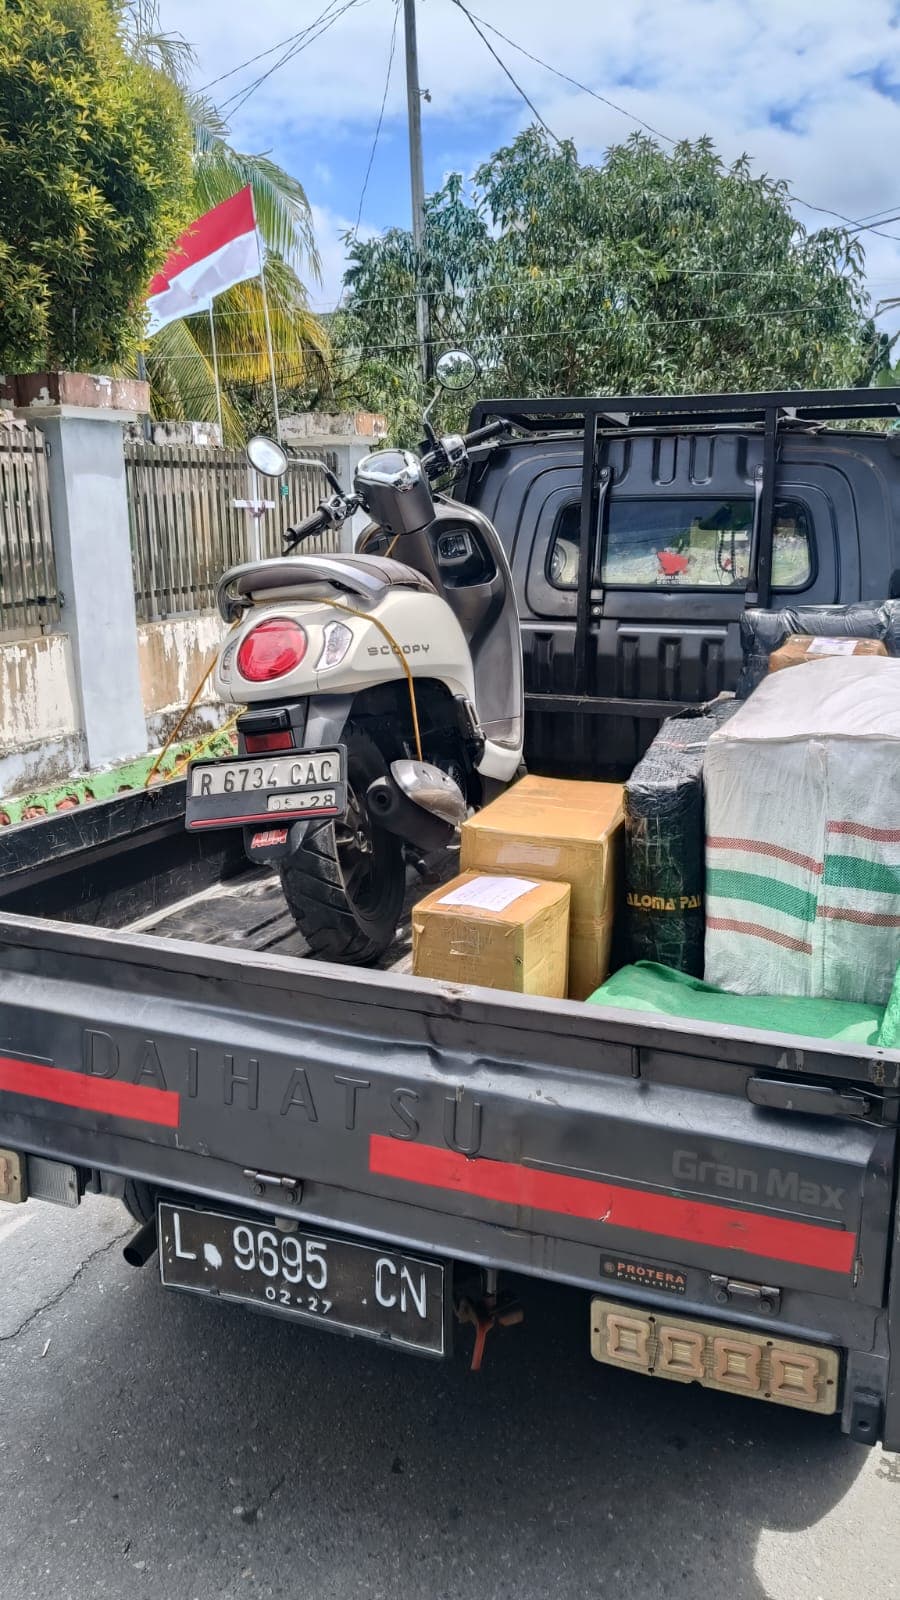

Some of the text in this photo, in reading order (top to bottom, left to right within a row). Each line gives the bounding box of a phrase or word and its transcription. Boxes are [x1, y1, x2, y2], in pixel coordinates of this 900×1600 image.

[201, 760, 332, 795] R 6734 CAC
[82, 1028, 482, 1156] DAIHATSU
[671, 1150, 846, 1211] Gran Max
[173, 1212, 427, 1319] L 9695 CN
[617, 1262, 685, 1284] PROTERA
[617, 1271, 685, 1292] Protection
